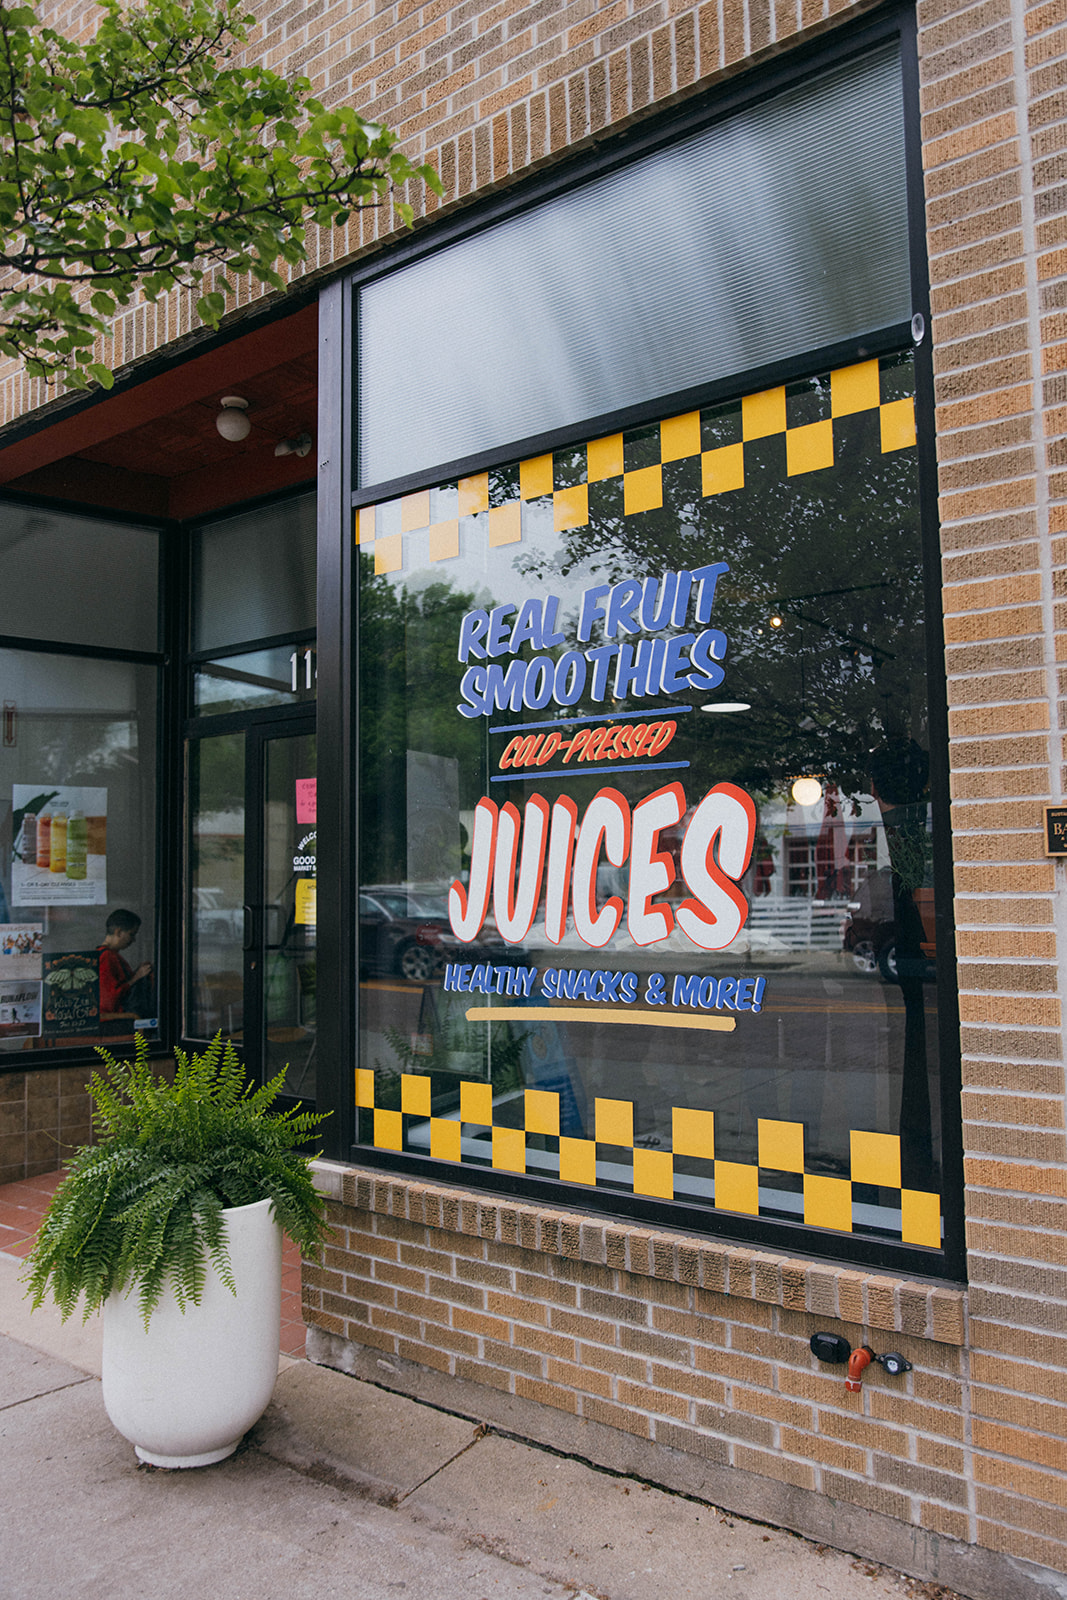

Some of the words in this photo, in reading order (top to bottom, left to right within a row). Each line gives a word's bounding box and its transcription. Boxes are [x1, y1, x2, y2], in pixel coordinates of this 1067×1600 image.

[458, 594, 566, 663] REAL
[577, 561, 730, 642] FRUIT
[289, 649, 317, 692] 11
[456, 628, 728, 719] SMOOTHIES
[499, 720, 677, 770] COLD-PRESSED
[448, 781, 757, 951] JUICES
[443, 964, 538, 997] HEALTHY
[540, 968, 639, 1004] SNACKS
[644, 972, 667, 1006] &
[671, 974, 767, 1013] MORE!
